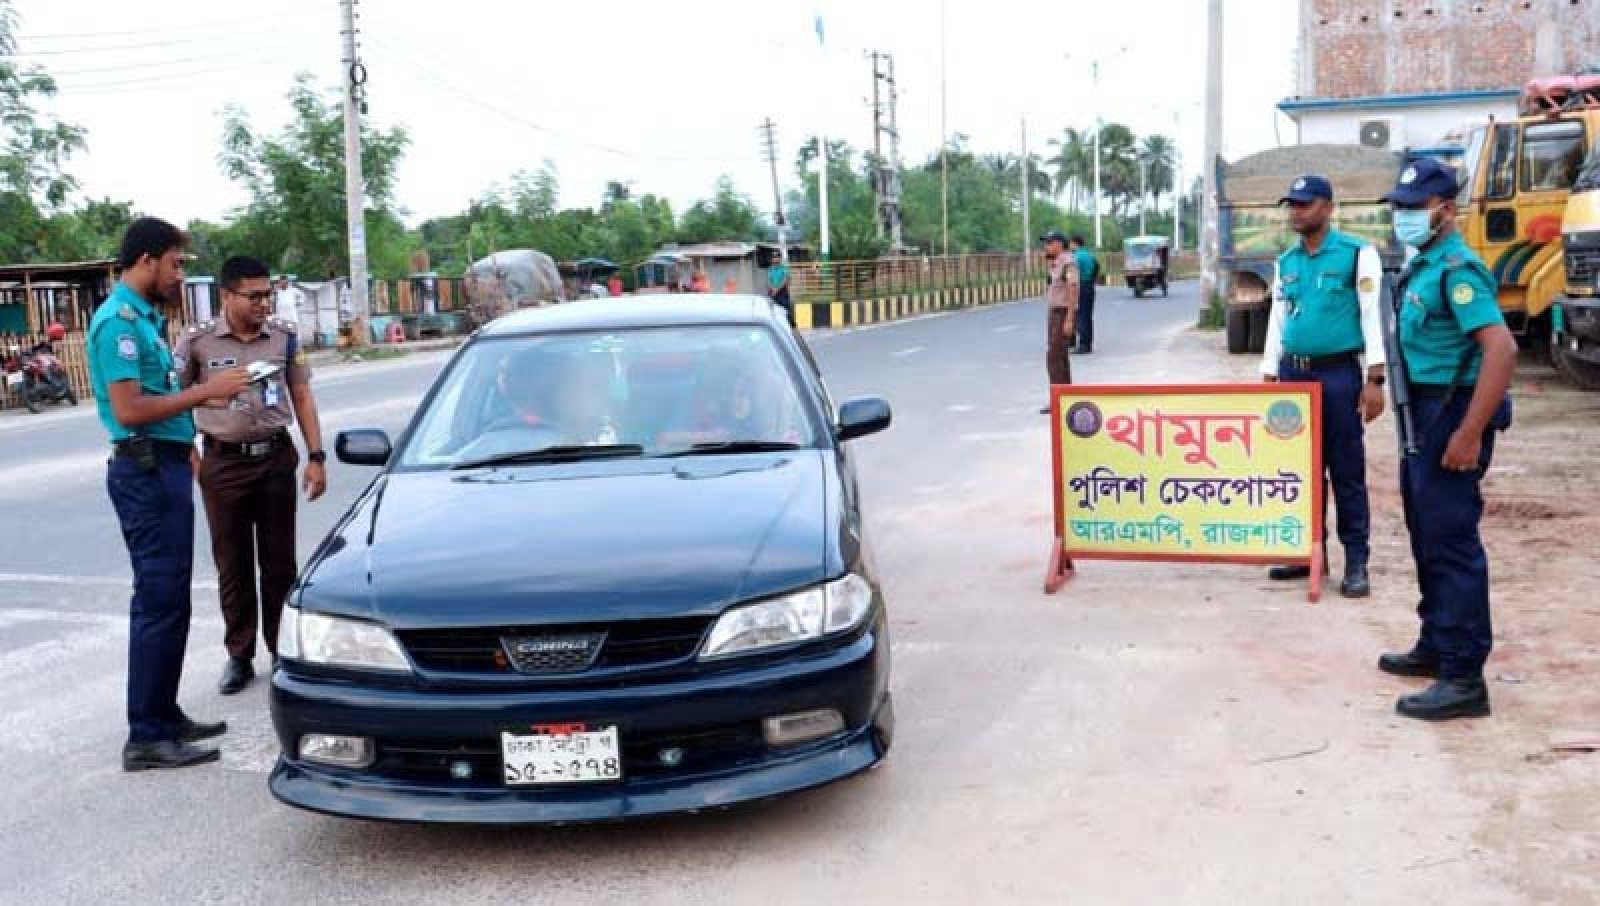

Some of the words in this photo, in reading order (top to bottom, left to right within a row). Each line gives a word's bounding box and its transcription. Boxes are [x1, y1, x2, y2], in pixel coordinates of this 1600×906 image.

[1105, 408, 1261, 469] থামুন
[1069, 466, 1148, 510] পুলিশ
[1159, 468, 1303, 509] চেকপোস্ট
[1070, 513, 1193, 547] আরএমপি,
[1200, 515, 1304, 548] রাজশাহী
